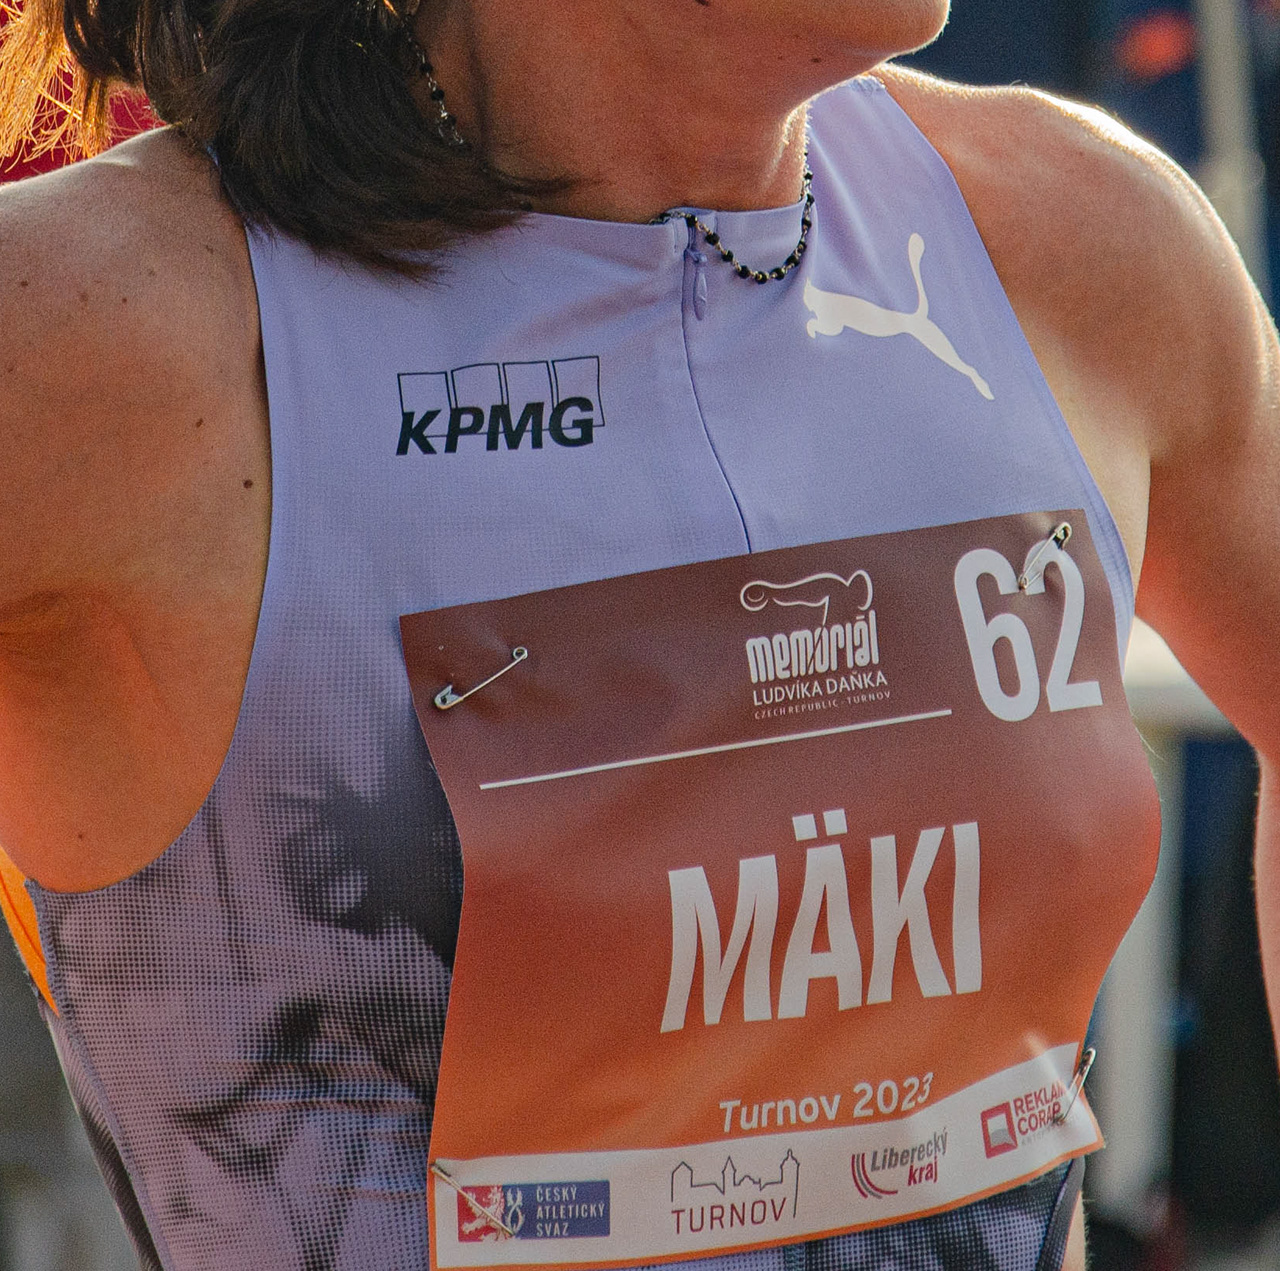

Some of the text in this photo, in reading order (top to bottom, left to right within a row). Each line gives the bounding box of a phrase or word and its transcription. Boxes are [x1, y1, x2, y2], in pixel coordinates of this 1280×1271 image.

[396, 396, 594, 456] KPMG
[954, 539, 1103, 722] 62
[753, 670, 888, 707] LUDVÍKA DAŇKA
[754, 707, 786, 720] CZECH
[788, 700, 838, 714] REPUBLIC
[847, 691, 891, 705] TURNOV
[660, 808, 982, 1033] MÄKI
[719, 1072, 934, 1133] Turnov 2023
[871, 1127, 948, 1172] Liberecký
[908, 1156, 938, 1186] kraj
[536, 1184, 577, 1203] ČESKÝ
[536, 1202, 606, 1220] ATLETICKÝ
[536, 1222, 570, 1237] SVAZ
[671, 1197, 787, 1235] TURNOV
